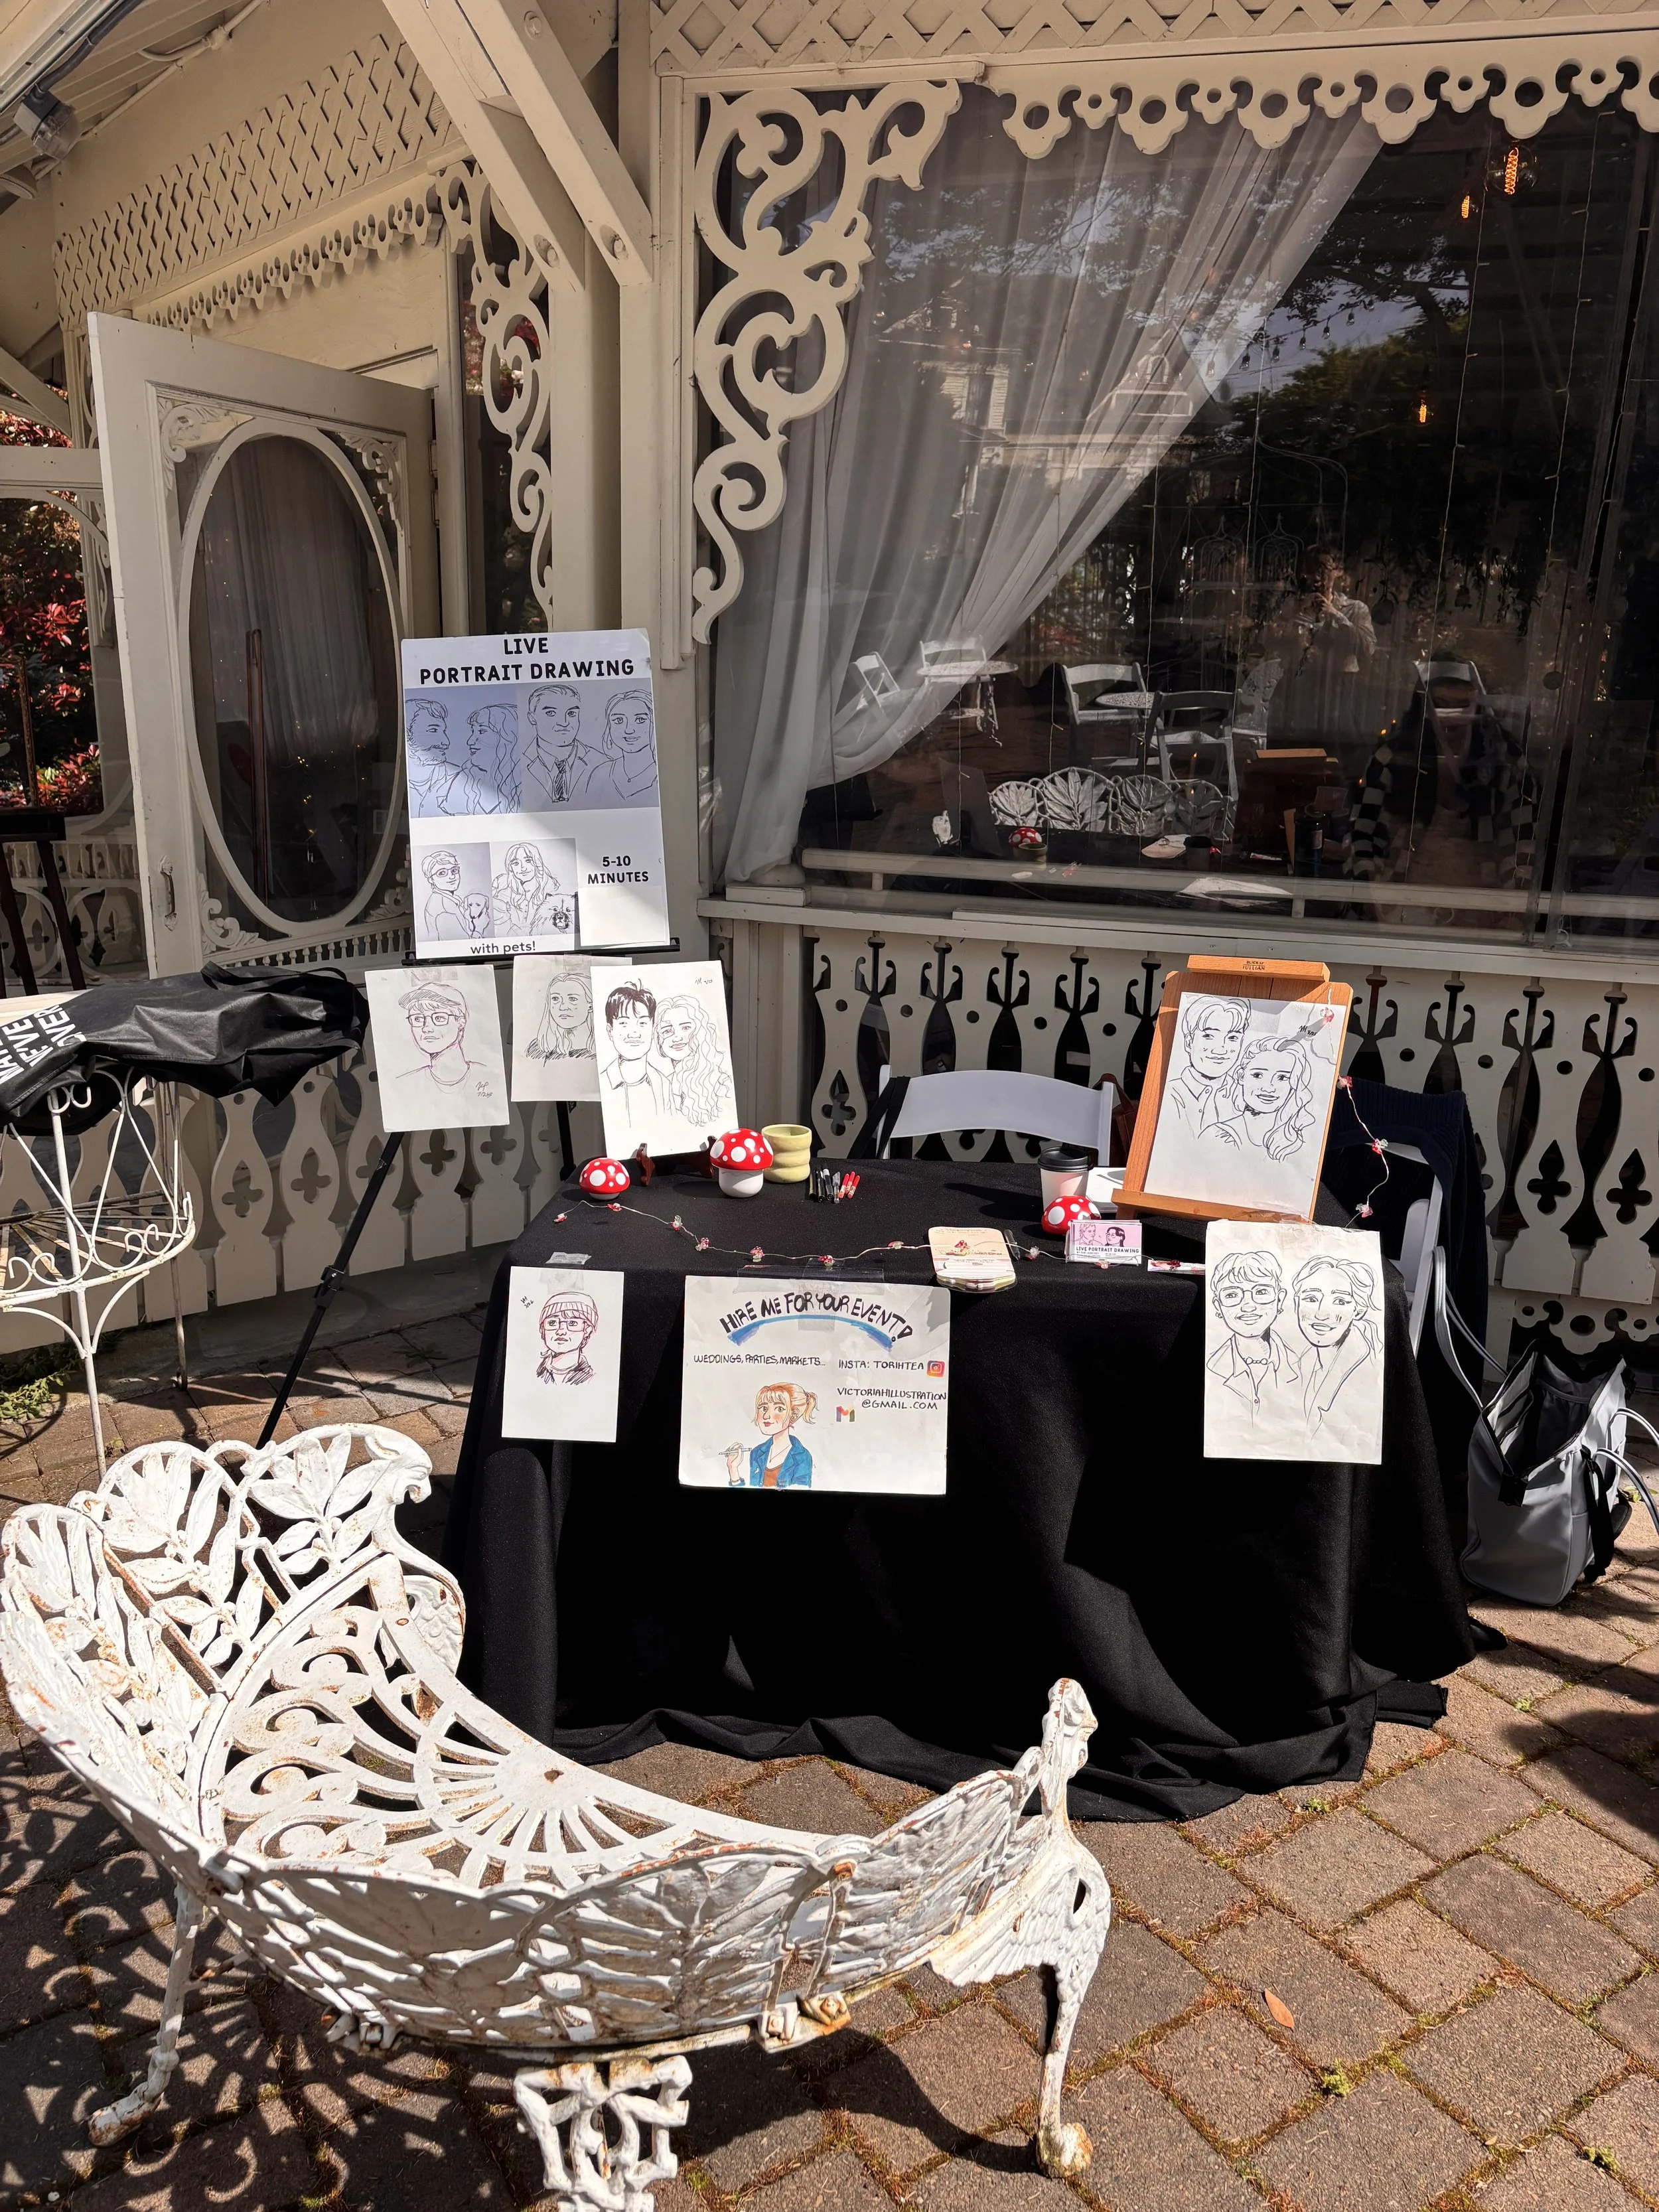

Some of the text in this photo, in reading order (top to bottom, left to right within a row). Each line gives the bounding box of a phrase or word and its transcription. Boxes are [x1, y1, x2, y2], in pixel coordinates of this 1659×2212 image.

[504, 637, 549, 655] LIVE
[420, 658, 634, 684] PORTRAIT DRAWING
[603, 855, 631, 867] 5-10
[587, 871, 649, 885] MINUTES
[470, 940, 536, 954] with pets!
[719, 1291, 912, 1342] HIRE ME FOR YOUR EVENT!
[693, 1355, 744, 1364] WEDDINGS,
[745, 1354, 779, 1364] PARTIES,
[839, 1359, 924, 1370] INSTA: TORIHTEA
[837, 1387, 947, 1400] VICTORIAHILLUSTRATION
[861, 1399, 938, 1410] @GMAIL.COM
